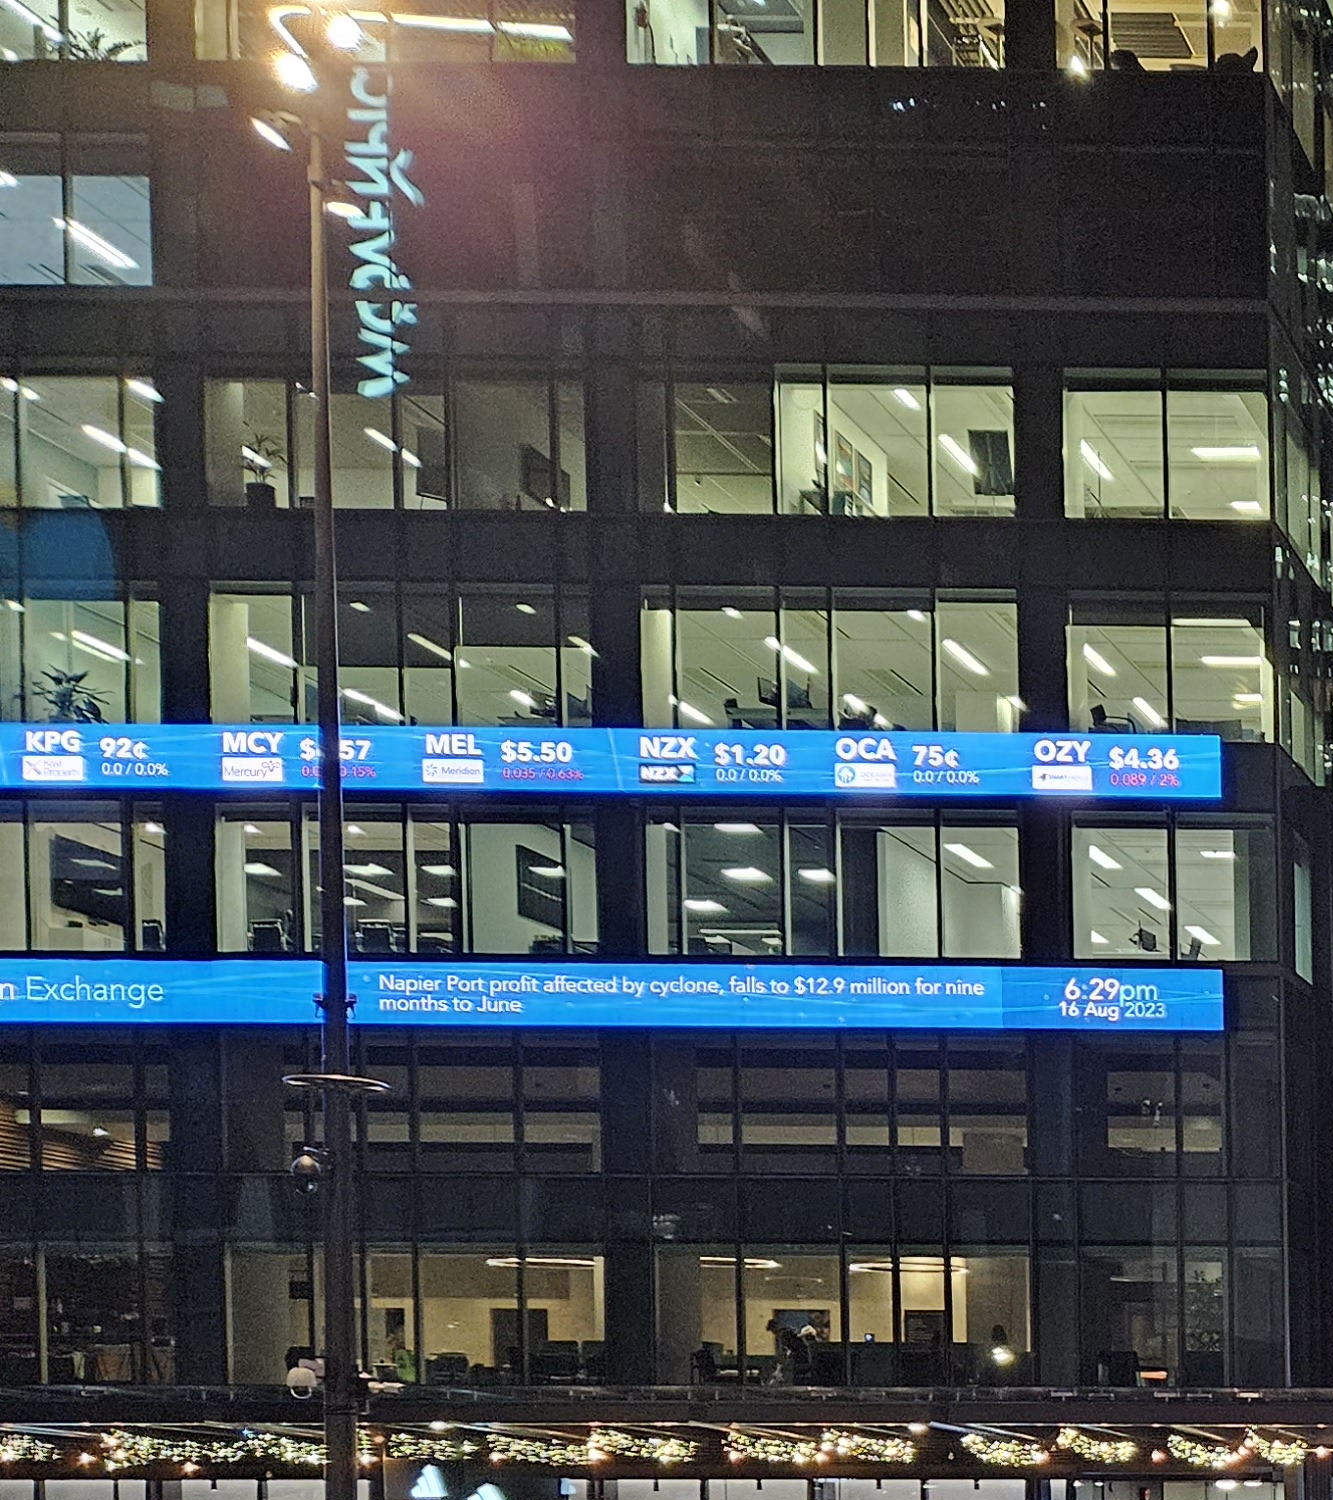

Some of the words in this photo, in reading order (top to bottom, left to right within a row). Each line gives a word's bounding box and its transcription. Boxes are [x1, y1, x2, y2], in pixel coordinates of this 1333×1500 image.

[25, 731, 81, 752] KPG
[100, 738, 148, 760] 92¢
[223, 732, 283, 754] MCY
[300, 738, 371, 761] $57
[426, 734, 482, 755] MEL
[501, 740, 573, 763] $5.50
[640, 737, 699, 760] NZX
[835, 737, 897, 761] OCA
[1034, 740, 1092, 763] OZY
[714, 743, 786, 766] $1.20
[912, 746, 959, 768] 75¢
[1109, 746, 1180, 770] $4.36
[101, 763, 122, 776] 0.0
[134, 763, 169, 776] 0.0%
[224, 766, 267, 779] Mercury
[441, 766, 481, 776] Meridian
[503, 768, 536, 779] 0.035
[641, 765, 680, 781] NZX
[716, 769, 737, 783] 0.0
[749, 769, 783, 783] 0.0%
[913, 771, 935, 784] 0.0
[946, 771, 980, 784] 0.0%
[1110, 773, 1147, 787] 0.089
[1160, 774, 1180, 787] 2%
[27, 975, 164, 1009] Exchange
[379, 975, 443, 996] Napier
[447, 975, 485, 993] Port
[490, 976, 538, 997] profit
[544, 976, 617, 993] affected
[622, 976, 646, 998] by
[650, 977, 725, 998] cyclone,
[729, 977, 765, 994] falls
[770, 979, 790, 994] to
[794, 976, 845, 996] $12.9
[850, 978, 910, 995] million
[915, 978, 941, 995] for
[946, 978, 985, 996] nine
[1064, 978, 1159, 1008] 6:29pm
[379, 996, 448, 1012] months
[452, 997, 473, 1012] to
[477, 996, 522, 1014] June
[1059, 1002, 1080, 1017] 16
[1083, 1002, 1120, 1021] Aug
[1124, 1002, 1167, 1018] 2023
